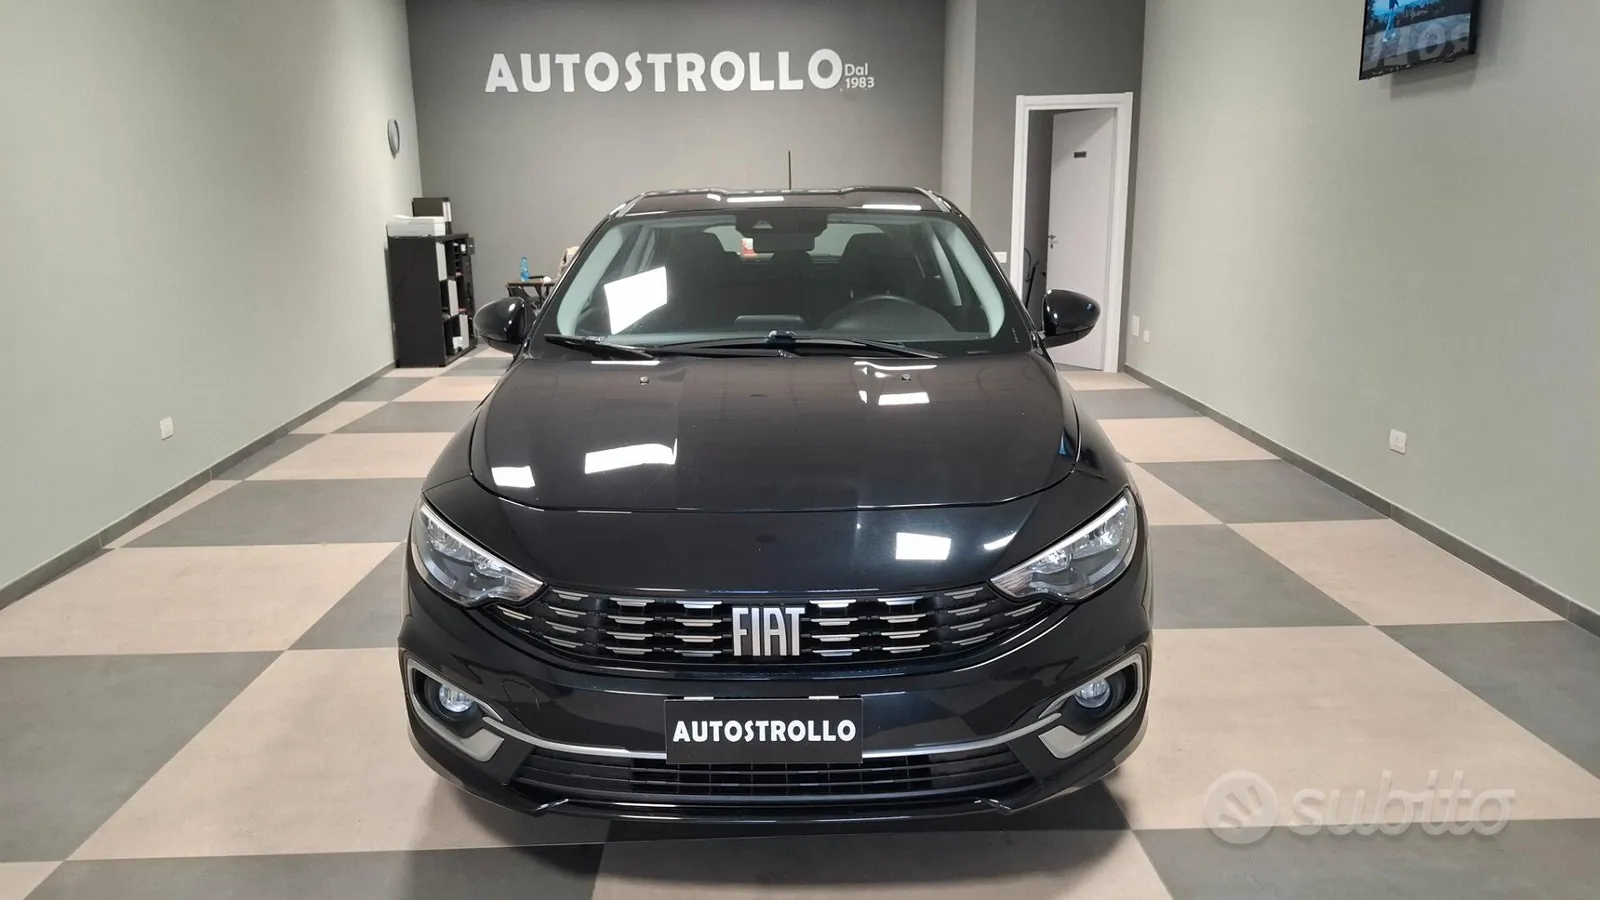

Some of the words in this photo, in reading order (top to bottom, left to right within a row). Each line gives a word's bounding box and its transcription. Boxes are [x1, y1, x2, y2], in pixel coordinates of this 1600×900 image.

[485, 48, 843, 93] AUTOSTROLLO
[845, 62, 869, 76] Dal
[845, 77, 875, 89] 1983
[732, 607, 806, 656] FIAT
[672, 719, 857, 743] AUTOSTROLLO
